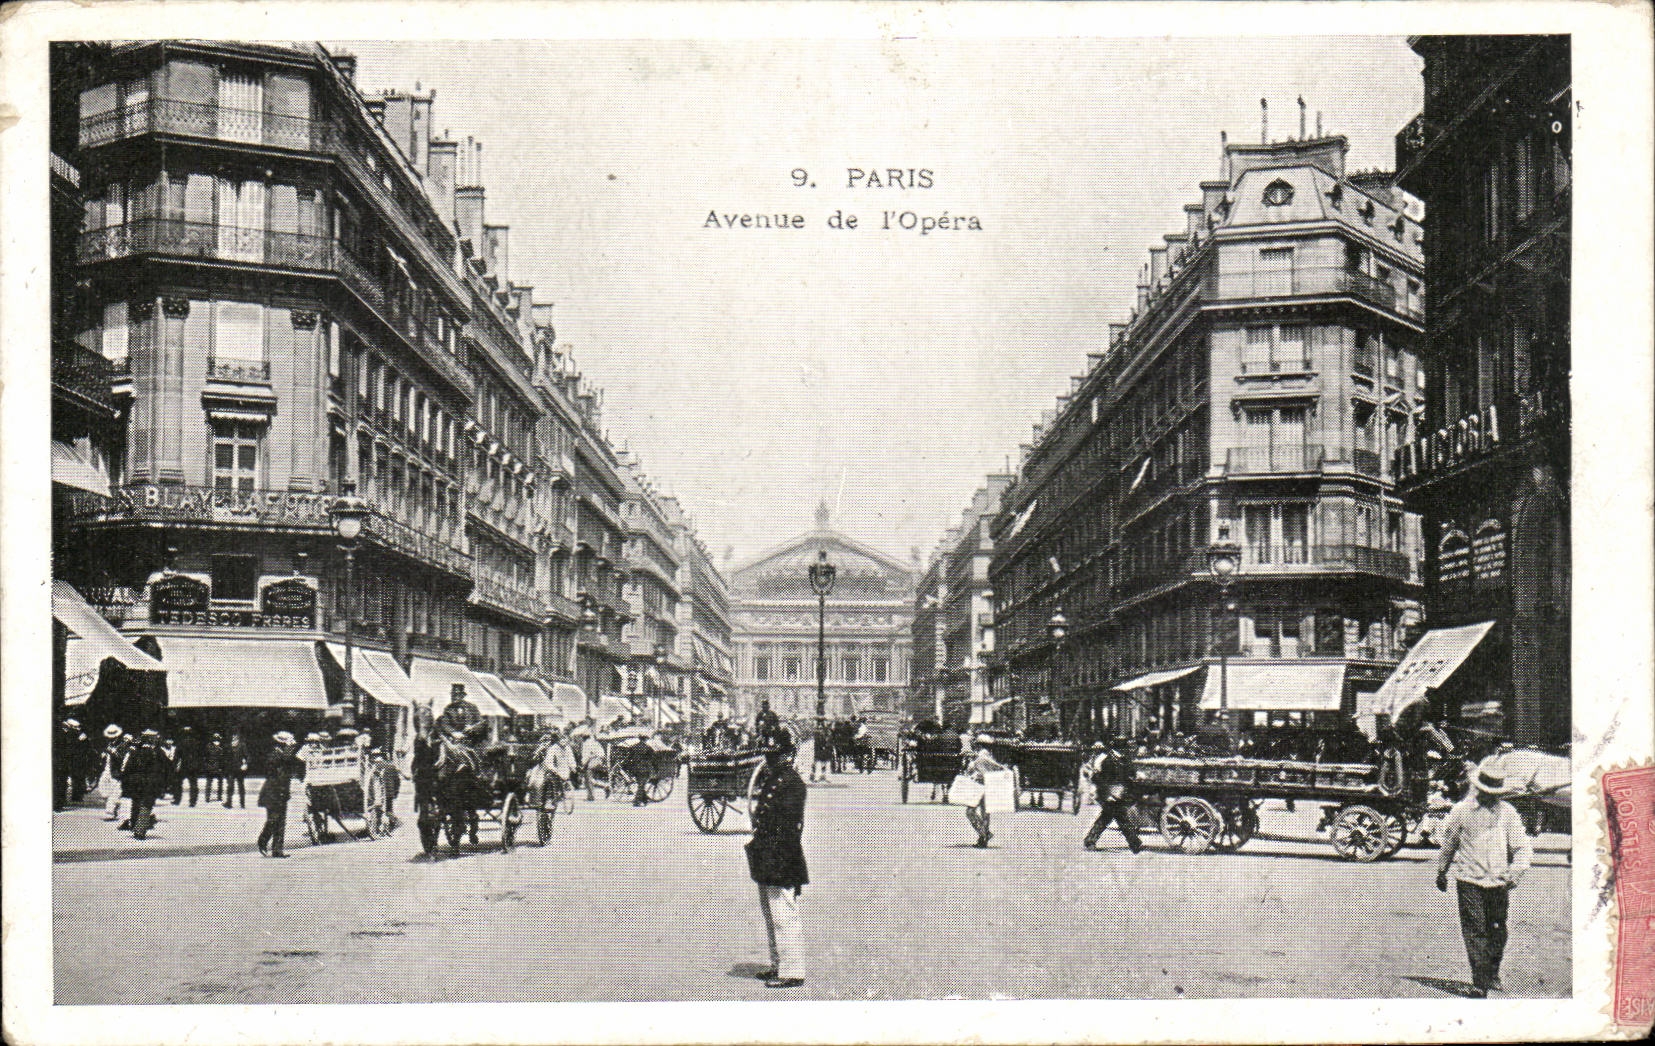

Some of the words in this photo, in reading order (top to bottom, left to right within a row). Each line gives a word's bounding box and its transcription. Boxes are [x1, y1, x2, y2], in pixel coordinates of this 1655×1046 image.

[144, 484, 213, 511] BLAY
[158, 609, 243, 627] TEDESCO
[1617, 787, 1642, 870] POSTES
